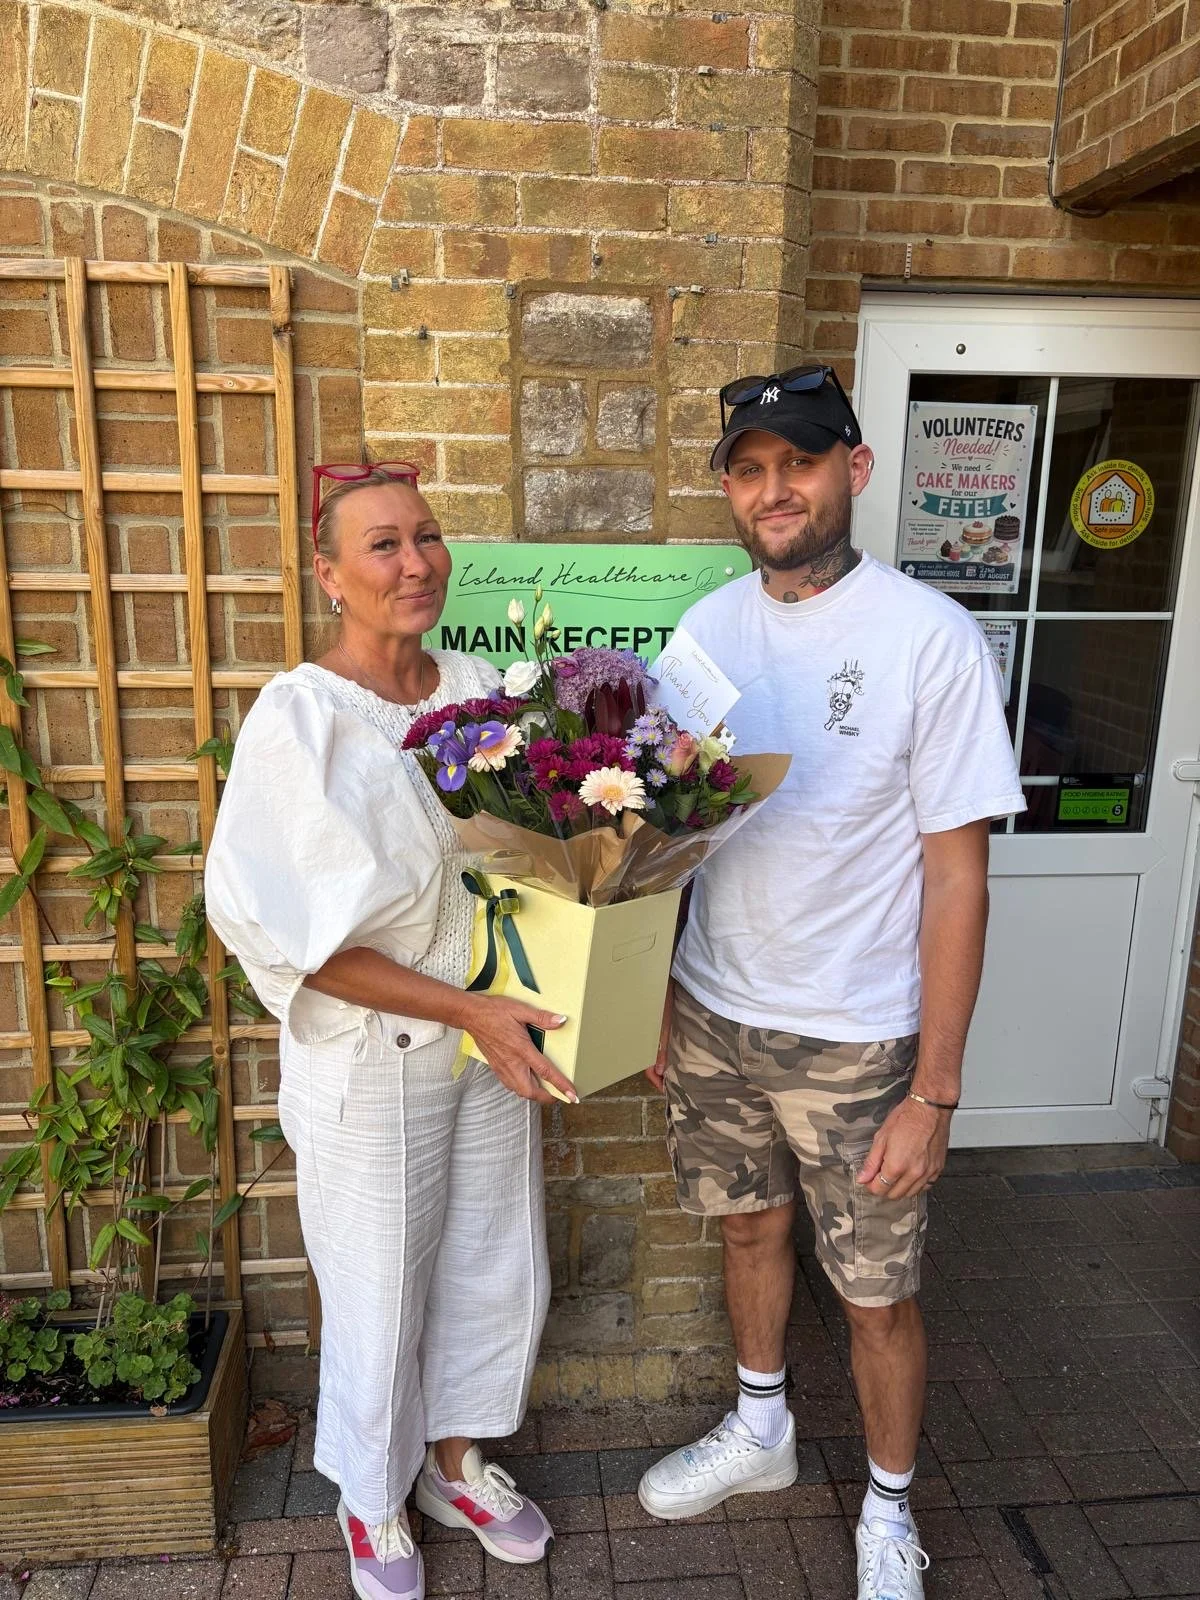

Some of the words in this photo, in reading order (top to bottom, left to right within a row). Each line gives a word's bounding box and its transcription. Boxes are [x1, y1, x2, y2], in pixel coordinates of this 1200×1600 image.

[760, 386, 781, 405] NY
[922, 417, 1025, 442] VOLUNTEERS
[943, 438, 1001, 456] Needed!
[964, 464, 981, 472] need
[916, 472, 953, 488] CAKE
[958, 473, 1016, 491] MAKERS
[938, 499, 991, 516] FETE!
[458, 563, 542, 588] Island
[550, 561, 692, 587] Healthcare
[441, 626, 526, 652] MAIN
[660, 656, 690, 698] Thank
[687, 691, 712, 727] You
[1114, 805, 1121, 815] 5
